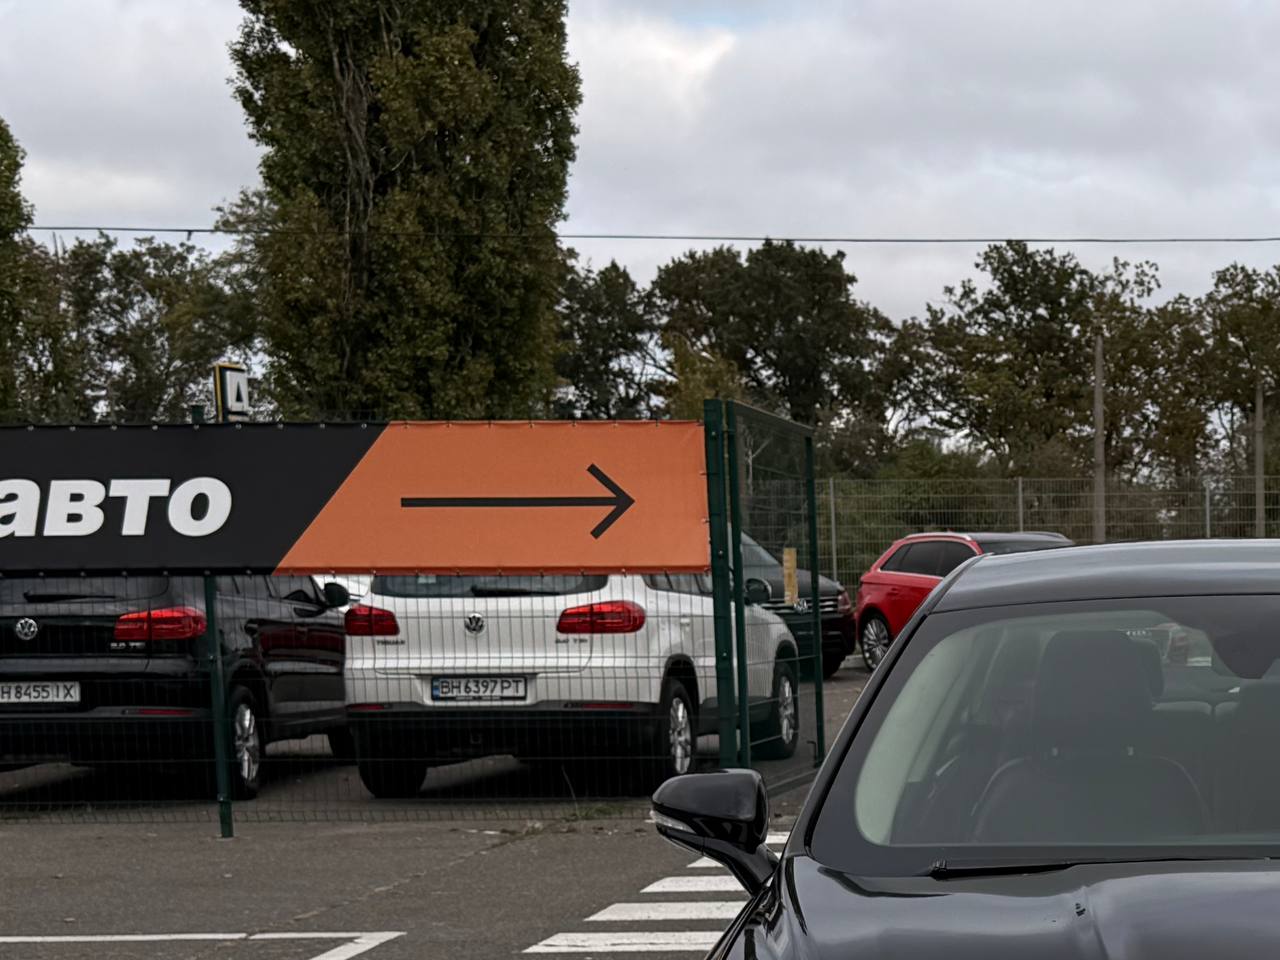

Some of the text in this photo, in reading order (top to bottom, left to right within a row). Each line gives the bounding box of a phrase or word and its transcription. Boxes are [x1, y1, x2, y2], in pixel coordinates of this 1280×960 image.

[0, 477, 232, 538] авто
[15, 684, 50, 699] 8455
[441, 680, 522, 694] BH 6397 PT
